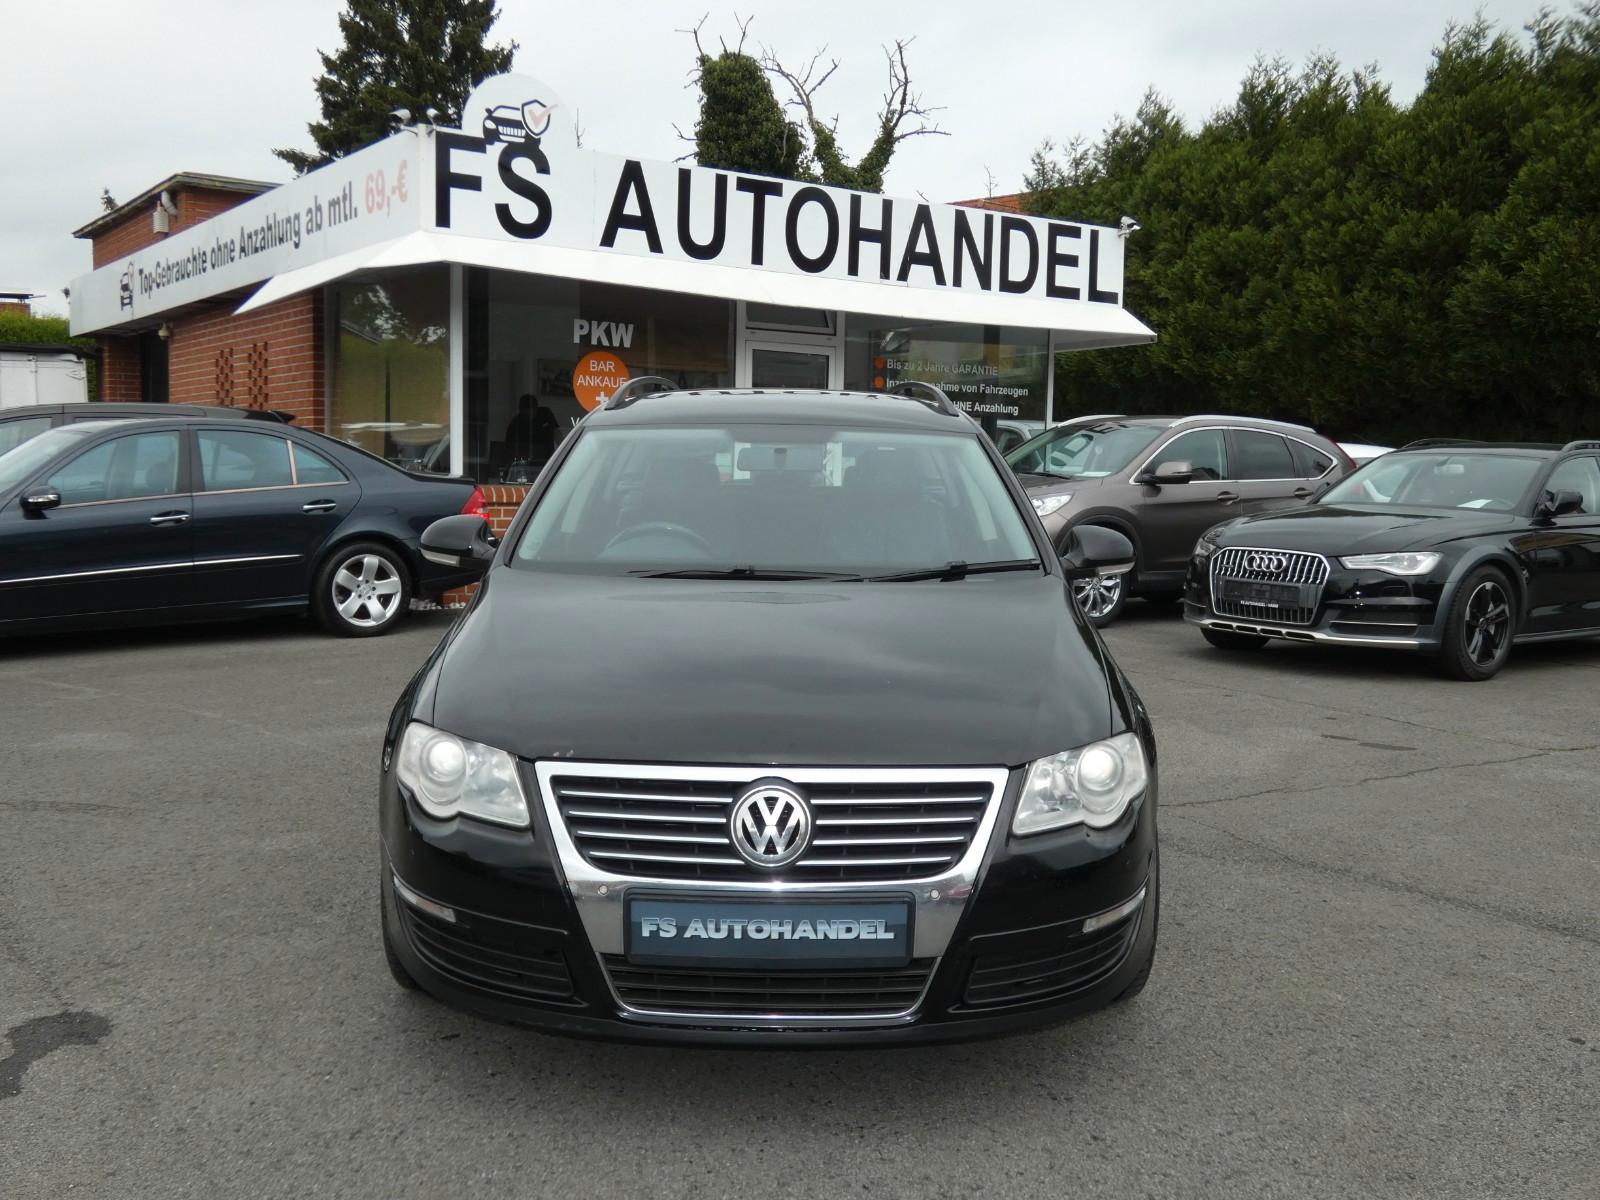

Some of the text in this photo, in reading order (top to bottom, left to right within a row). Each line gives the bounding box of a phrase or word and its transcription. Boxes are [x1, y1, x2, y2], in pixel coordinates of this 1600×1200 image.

[435, 130, 1119, 304] FS AUTOHANDEL
[138, 247, 208, 299] Top-Gebrauchte
[211, 237, 235, 270] ohne
[239, 212, 301, 259] Anzahlung
[306, 195, 323, 235] ab
[328, 181, 358, 227] mtl.
[573, 319, 634, 348] PKW
[590, 360, 615, 372] BAR
[887, 359, 902, 370] Bis
[951, 363, 999, 377] GARANTIE
[961, 385, 978, 393] von
[980, 383, 1029, 398] Fahrzeugen
[974, 402, 1019, 416] Anzahlung
[738, 793, 804, 858] VW
[641, 917, 896, 940] FS AUTOHANDEL
